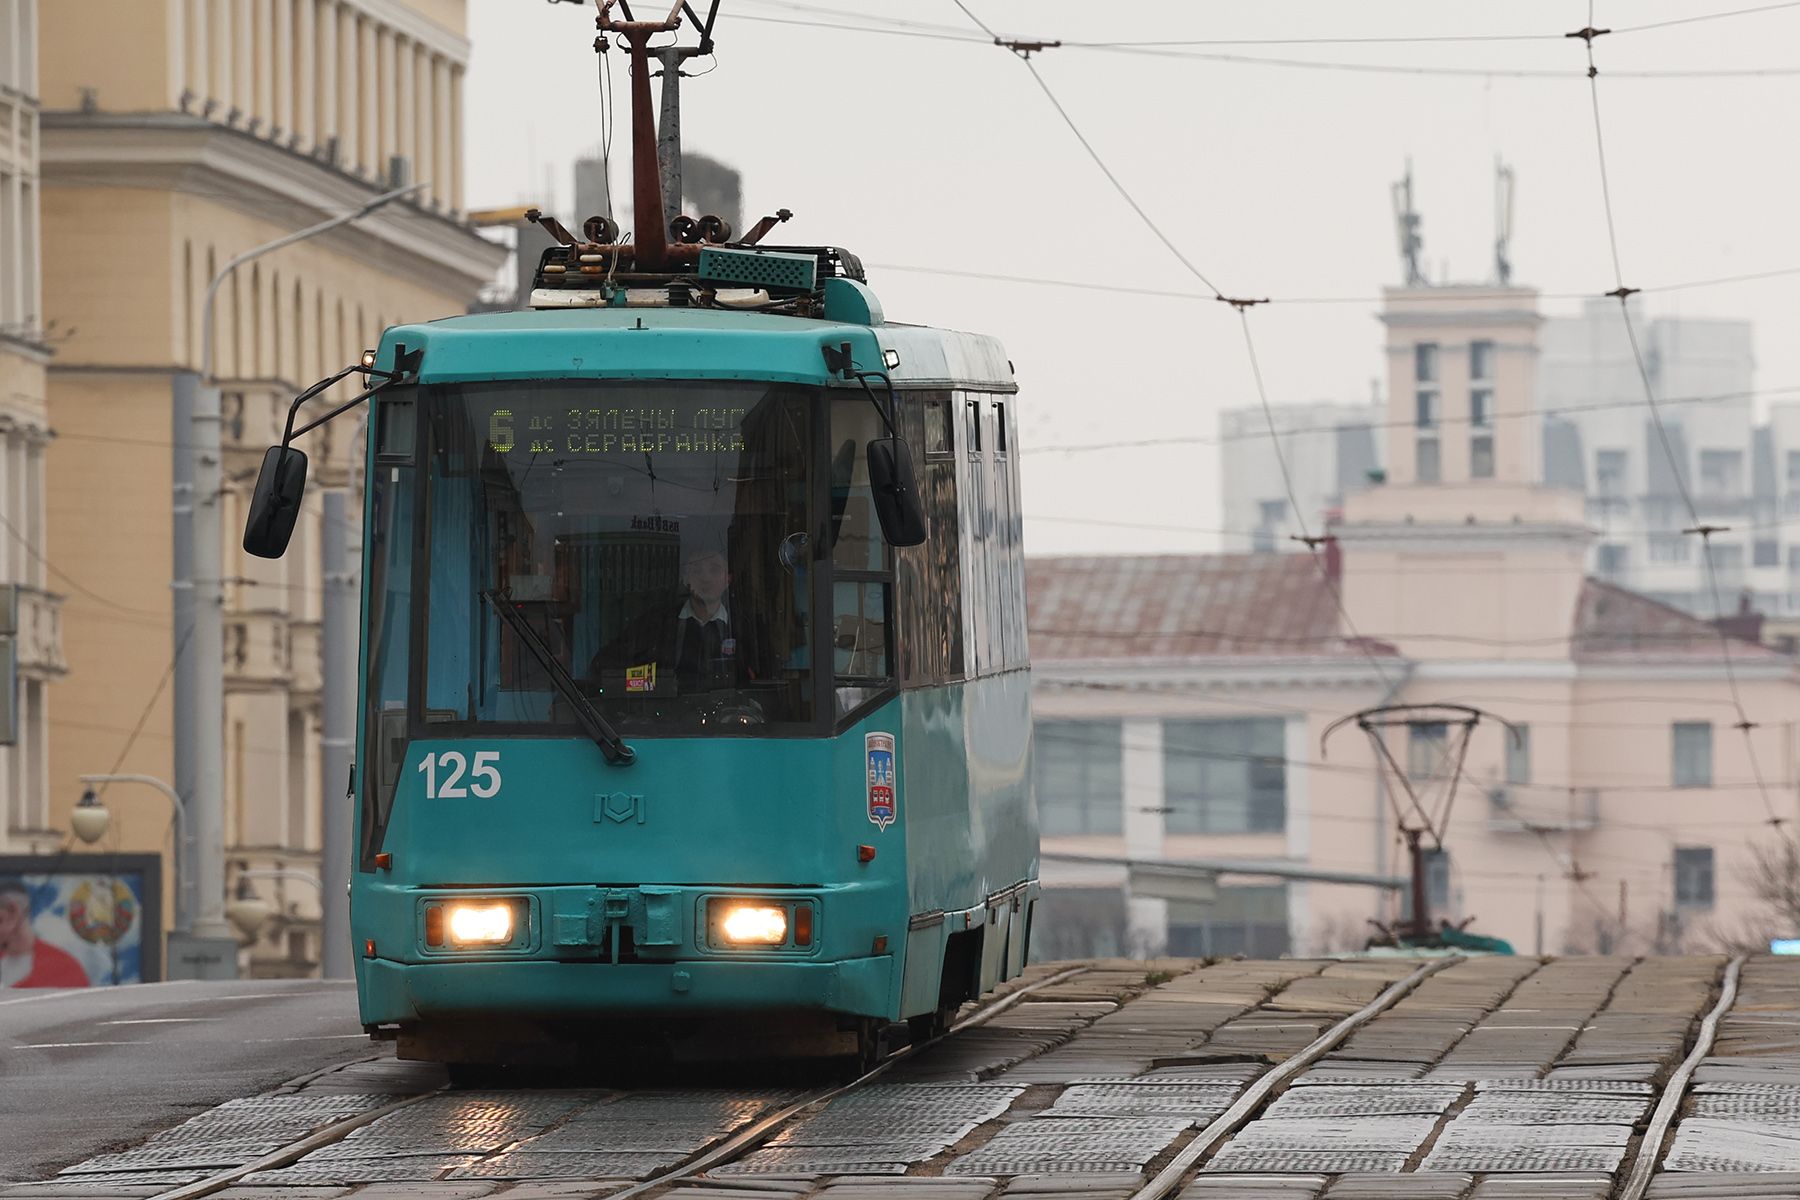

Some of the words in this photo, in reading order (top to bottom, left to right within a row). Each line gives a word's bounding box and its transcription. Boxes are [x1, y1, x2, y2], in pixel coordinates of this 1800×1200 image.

[489, 409, 515, 452] 6
[567, 433, 745, 452] СЕРАБРАНКА
[418, 751, 502, 799] 125
